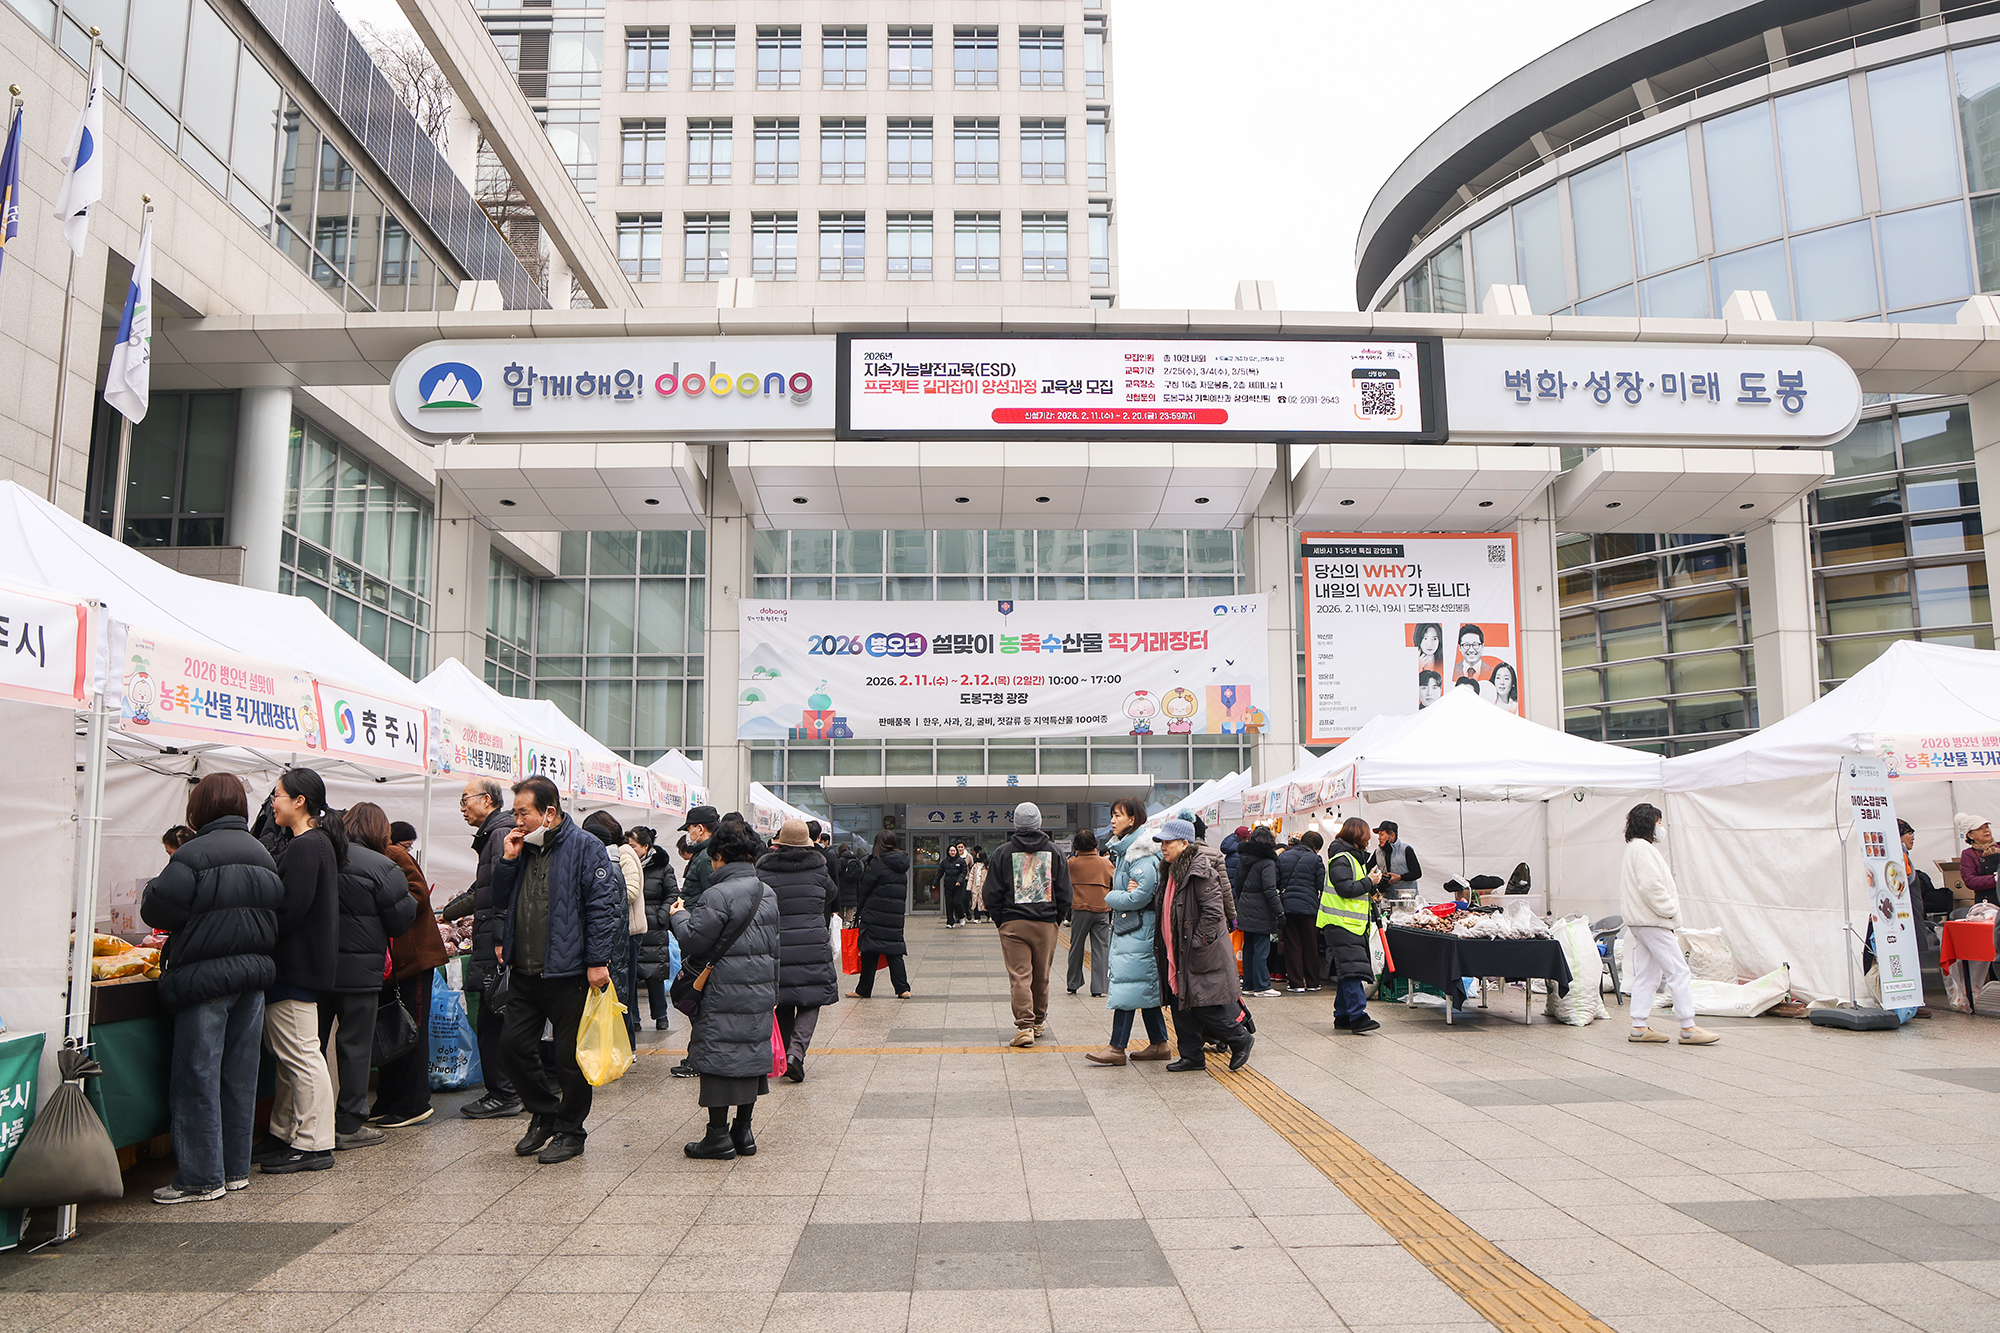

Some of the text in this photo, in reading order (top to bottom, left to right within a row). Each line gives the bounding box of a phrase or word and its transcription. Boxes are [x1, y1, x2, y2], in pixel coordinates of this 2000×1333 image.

[864, 352, 892, 360] 2026년
[864, 362, 1016, 377] 지속가능발전교육(ESD)
[1125, 366, 1154, 374] 교육기간
[503, 361, 814, 408] 함께해요! dobong
[864, 380, 1114, 394] 프로젝트 길라잡이 양성과정 교육생 모집
[1125, 380, 1155, 388] 교육장소
[1504, 368, 1808, 414] 변화·성장·미래 도봉
[1314, 564, 1422, 579] 당신의 WHY가
[1315, 582, 1470, 598] 내일의 WAY가 됩니다
[760, 607, 788, 616] dobong
[1316, 604, 1342, 614] 2026.
[1383, 604, 1401, 613] 19시
[1408, 604, 1440, 613] 도봉구청
[808, 630, 1209, 656] 2026 병오년 설맞이 농축수산물 직거래장터
[184, 656, 275, 696] 2026 병오년 설맞이
[866, 676, 897, 686] 2026.
[1012, 675, 1045, 686] (2일간)
[1048, 676, 1078, 686] 10:00
[1090, 674, 1122, 684] 17:00
[960, 692, 1028, 705] 도봉구청 광장
[160, 680, 300, 732] 농축수산물 직거래장터
[878, 717, 912, 727] 판매품목
[922, 717, 942, 727] 한우,
[944, 717, 961, 727] 사과,
[1023, 716, 1031, 725] 등
[1033, 716, 1073, 726] 지역특산물
[462, 727, 478, 744] 2026
[1920, 737, 1951, 748] 2026
[1952, 736, 1979, 748] 병오년
[1904, 751, 1968, 769] 농축수산물
